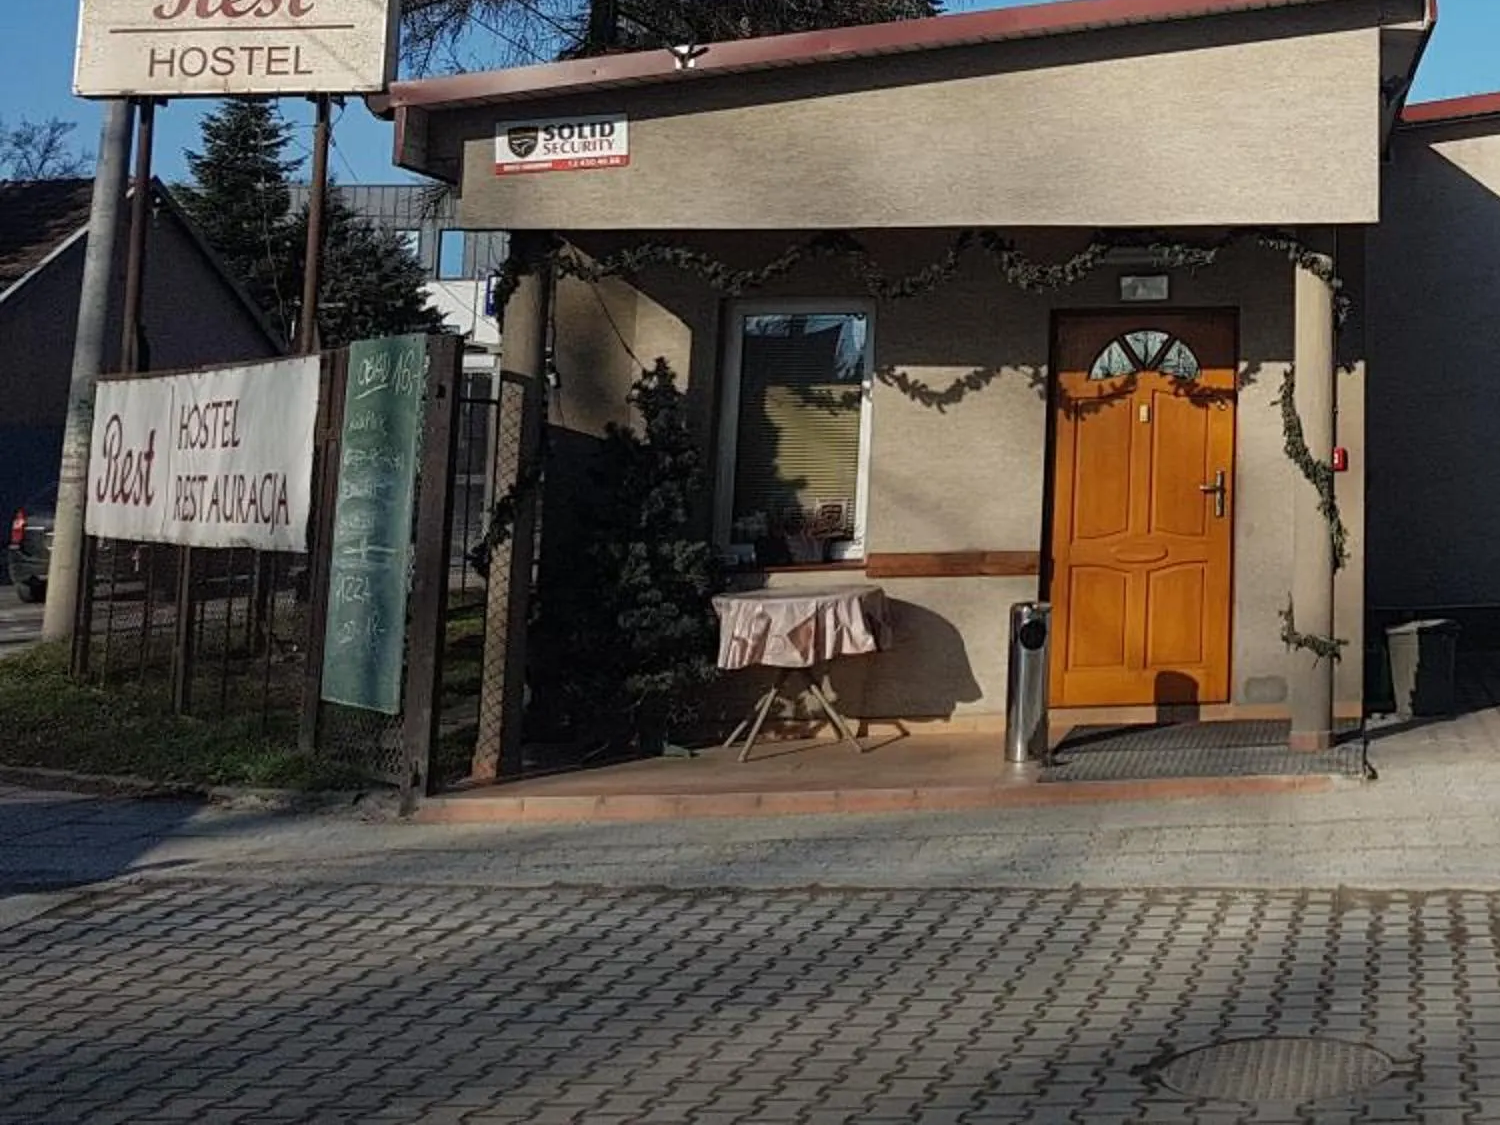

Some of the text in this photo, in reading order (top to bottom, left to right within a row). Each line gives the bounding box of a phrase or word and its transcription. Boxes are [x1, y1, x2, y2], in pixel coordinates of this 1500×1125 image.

[148, 46, 313, 78] HOSTEL
[543, 122, 615, 141] SOLID
[543, 139, 615, 155] SECURITY
[177, 399, 240, 449] HOSTEL
[97, 414, 156, 506] Rest
[173, 473, 289, 535] RESTAURACJA
